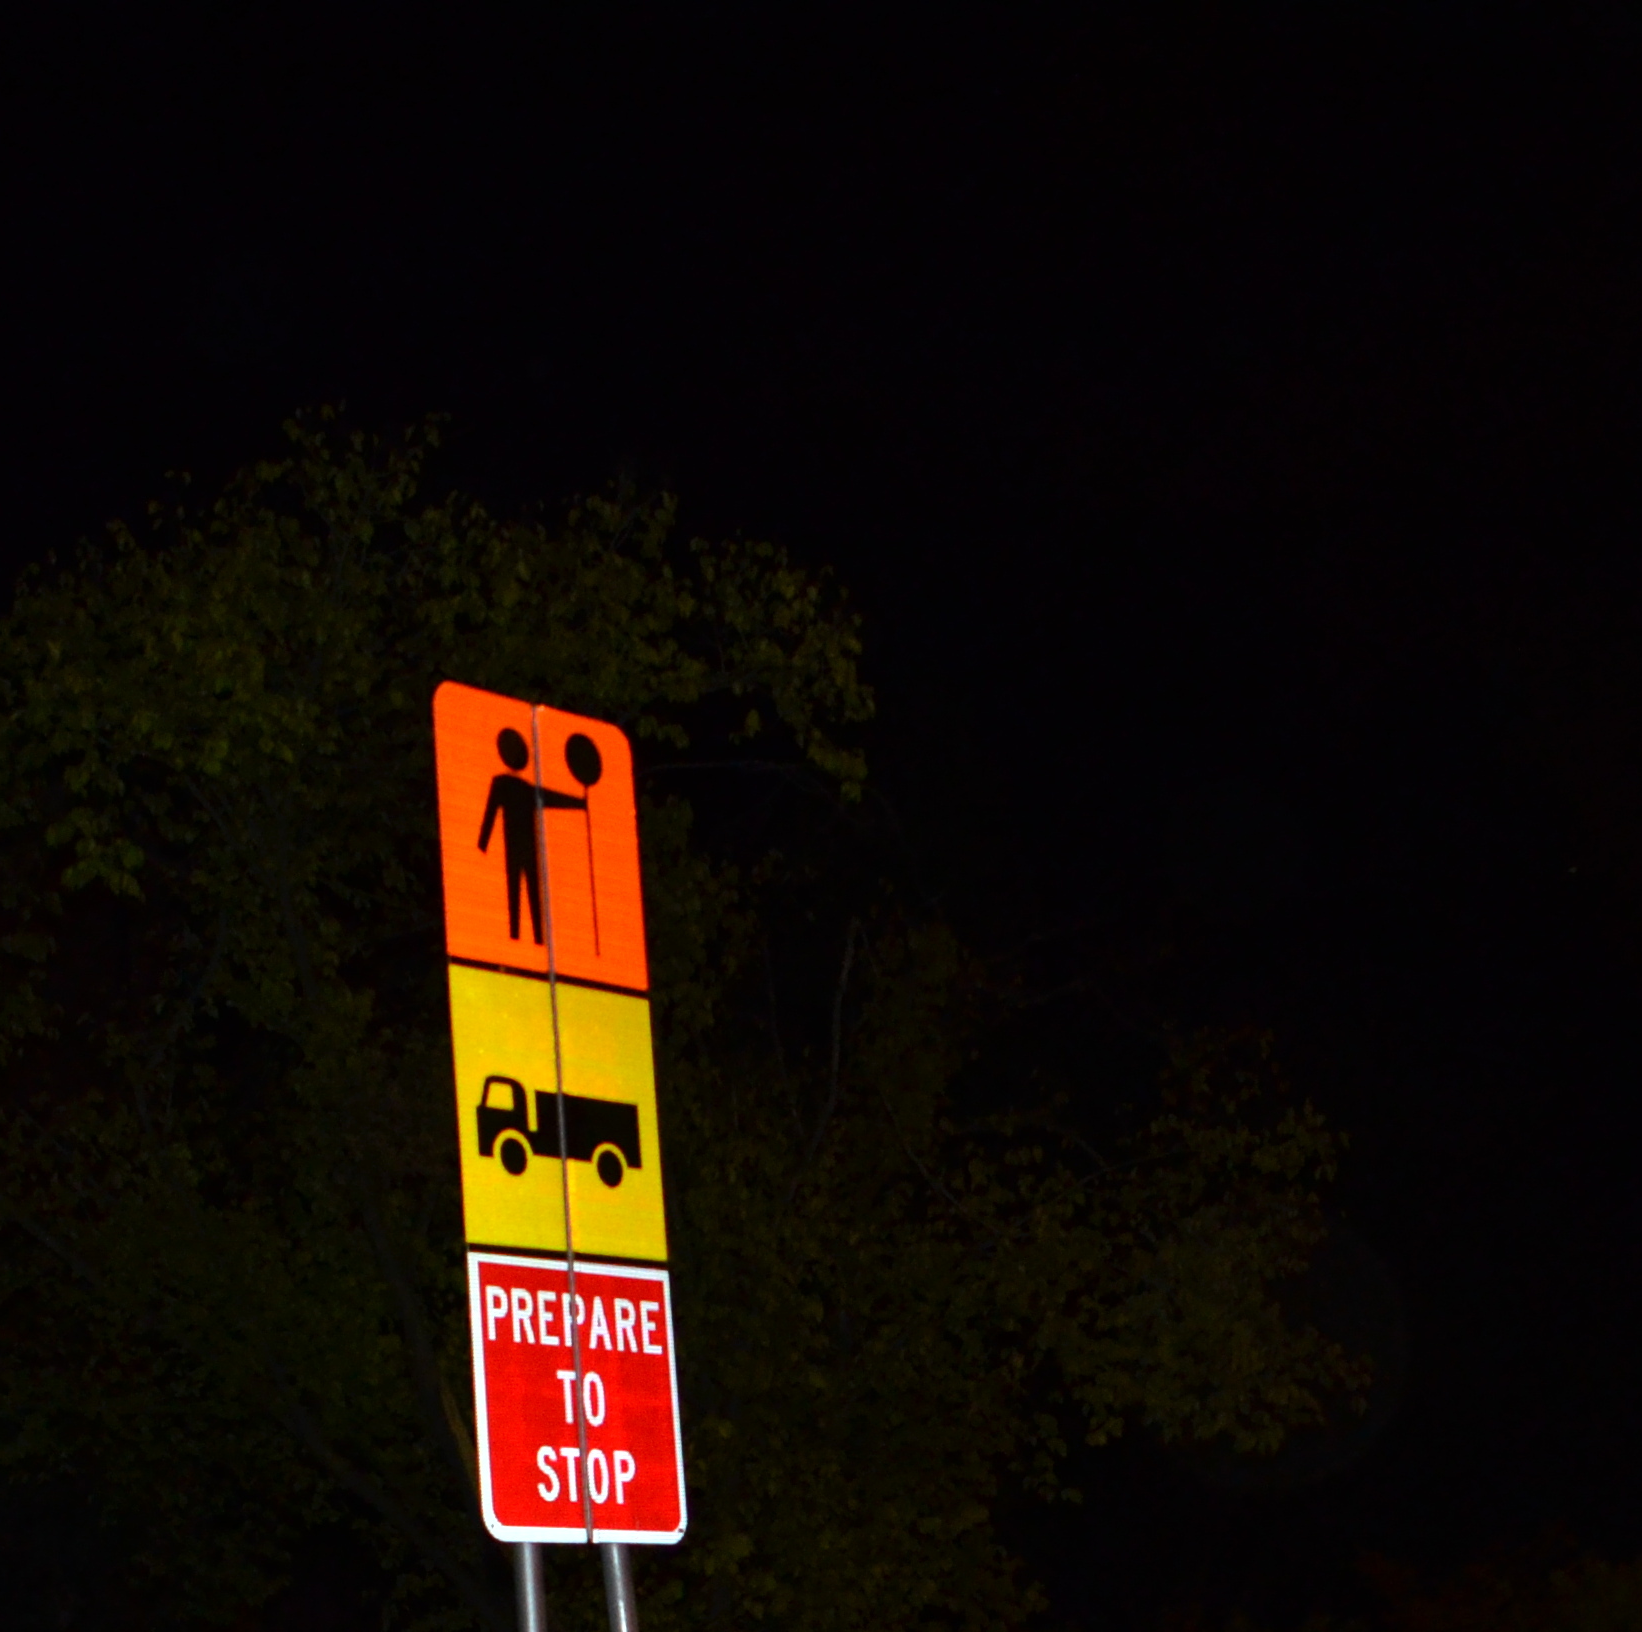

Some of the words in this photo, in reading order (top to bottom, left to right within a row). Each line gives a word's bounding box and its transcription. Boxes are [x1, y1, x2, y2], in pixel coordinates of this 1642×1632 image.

[484, 1284, 663, 1355] PREPARE
[556, 1369, 606, 1428] TO
[535, 1444, 637, 1505] STOP
